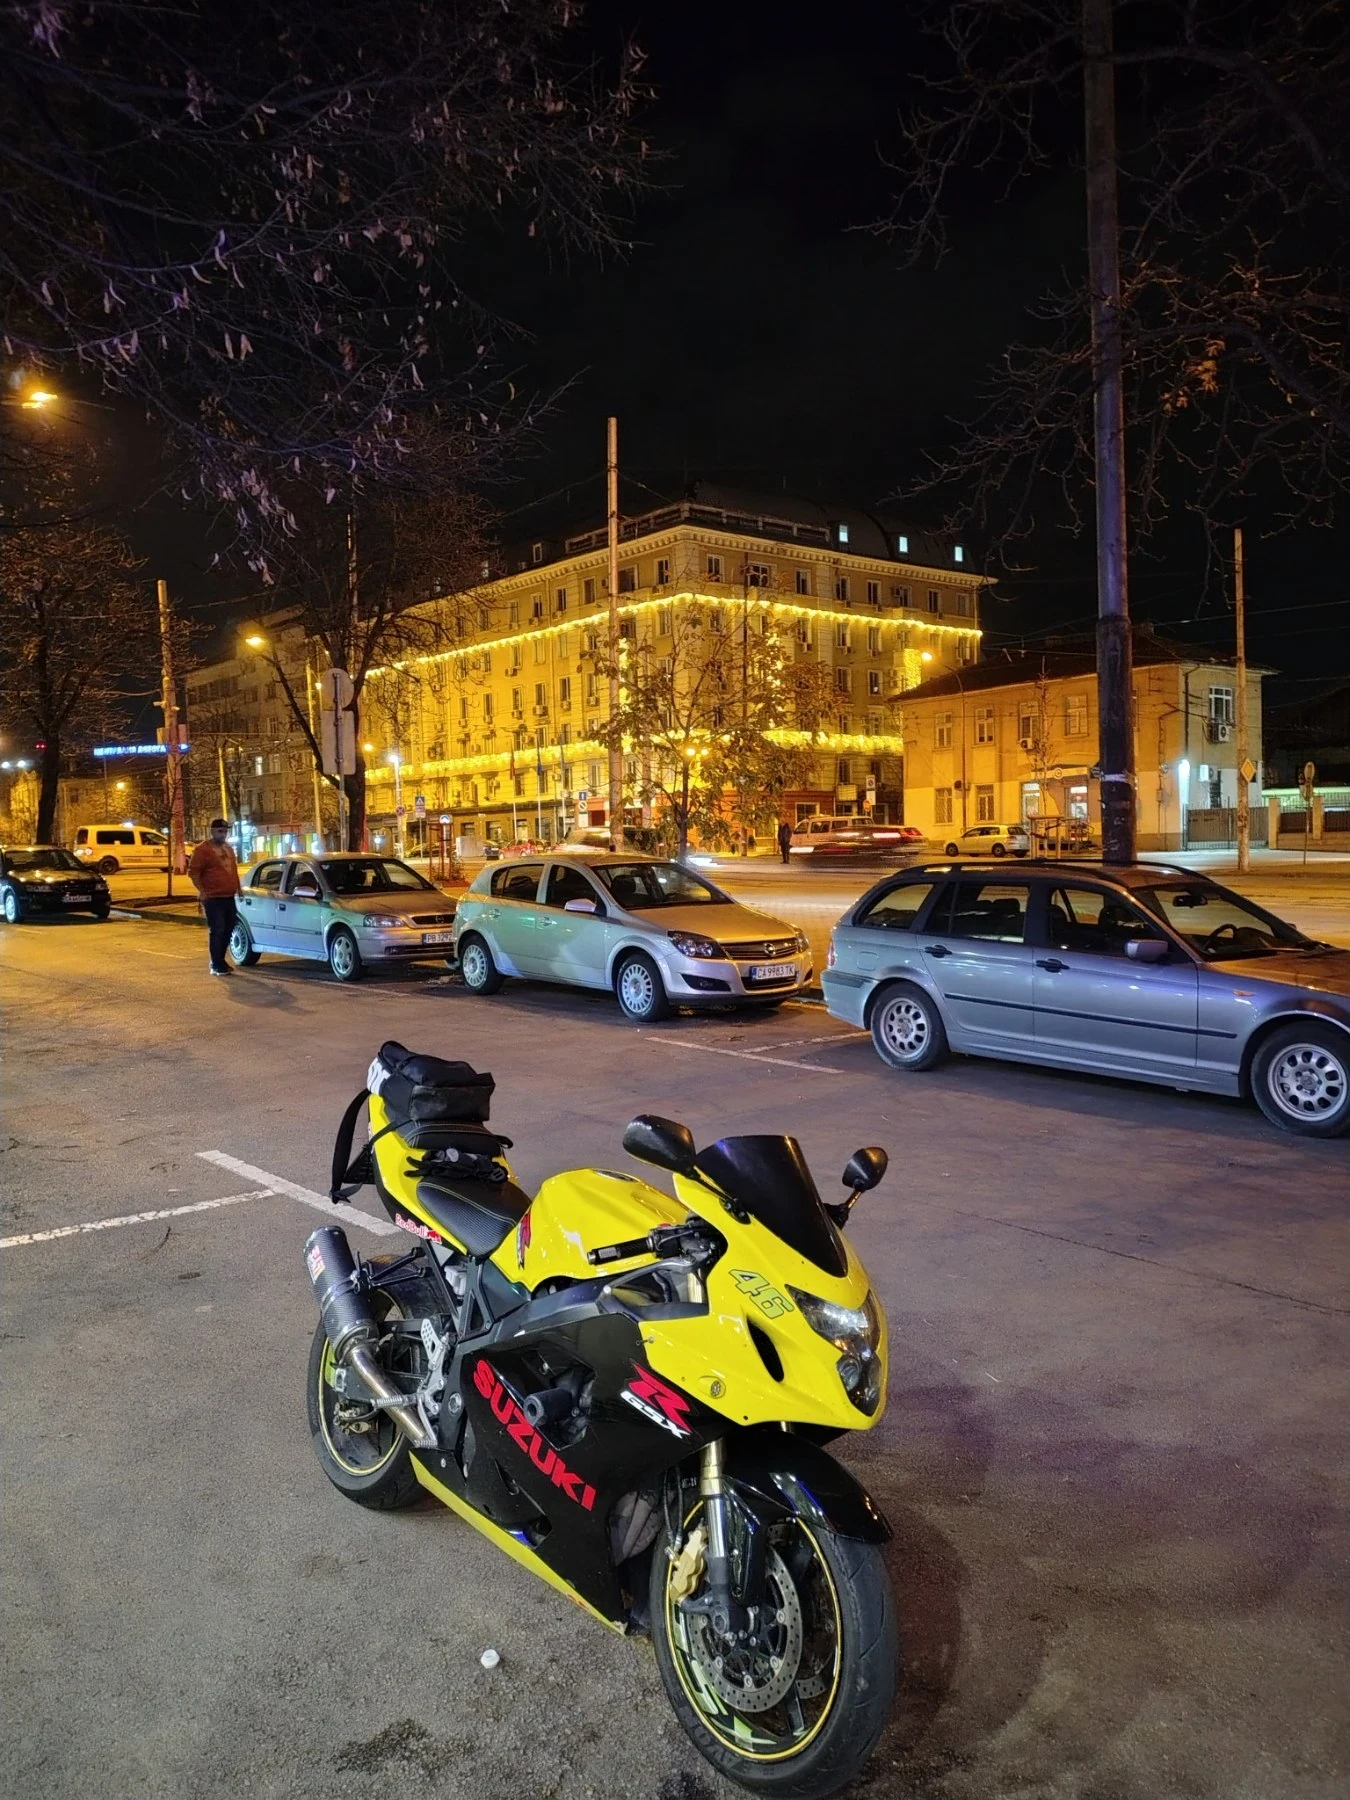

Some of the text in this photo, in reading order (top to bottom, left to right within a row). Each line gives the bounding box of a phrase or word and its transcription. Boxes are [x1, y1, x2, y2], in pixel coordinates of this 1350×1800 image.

[785, 965, 794, 975] TK
[728, 1269, 794, 1319] 46
[473, 1359, 597, 1511] SUZUKI
